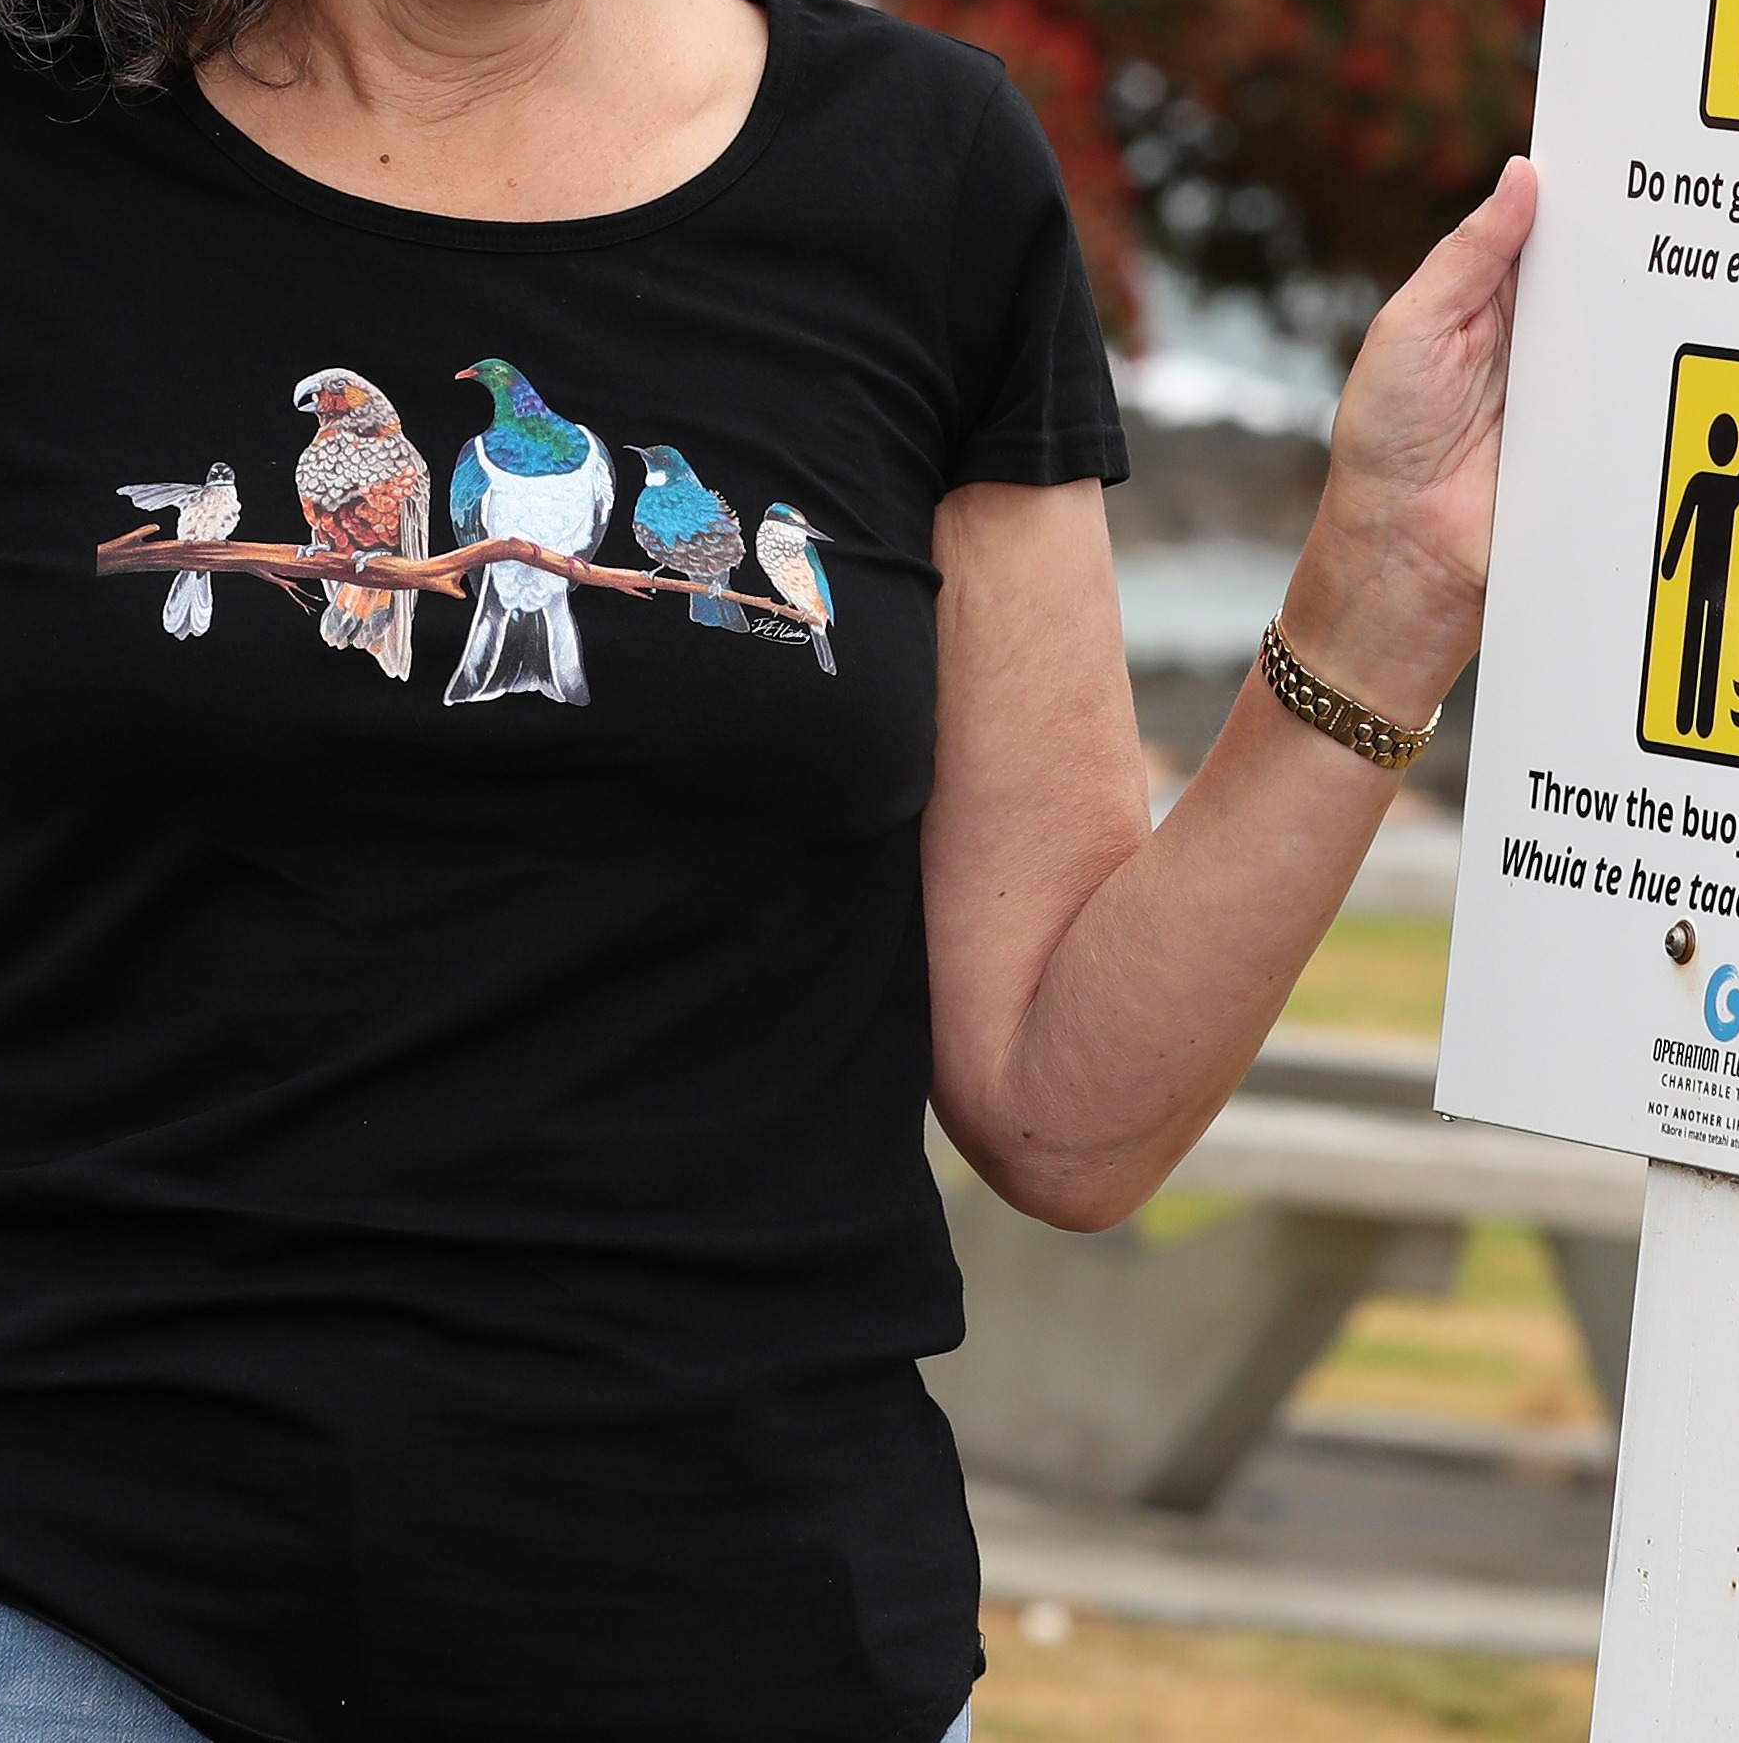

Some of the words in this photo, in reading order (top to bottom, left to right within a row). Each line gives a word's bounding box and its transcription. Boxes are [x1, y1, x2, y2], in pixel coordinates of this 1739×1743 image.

[1627, 159, 1665, 202] Do
[1673, 172, 1724, 210] not
[1647, 234, 1720, 280] Kaua
[1528, 769, 1619, 823] Throw
[1626, 787, 1674, 834] the
[1502, 836, 1588, 890] Whuia
[1593, 857, 1623, 896] te
[1628, 858, 1682, 907] hue
[1652, 1037, 1720, 1073] OPERATION
[1661, 1073, 1731, 1100] CHARITABLE
[1648, 1102, 1669, 1117] NOT
[1672, 1107, 1722, 1127] ANOTHER
